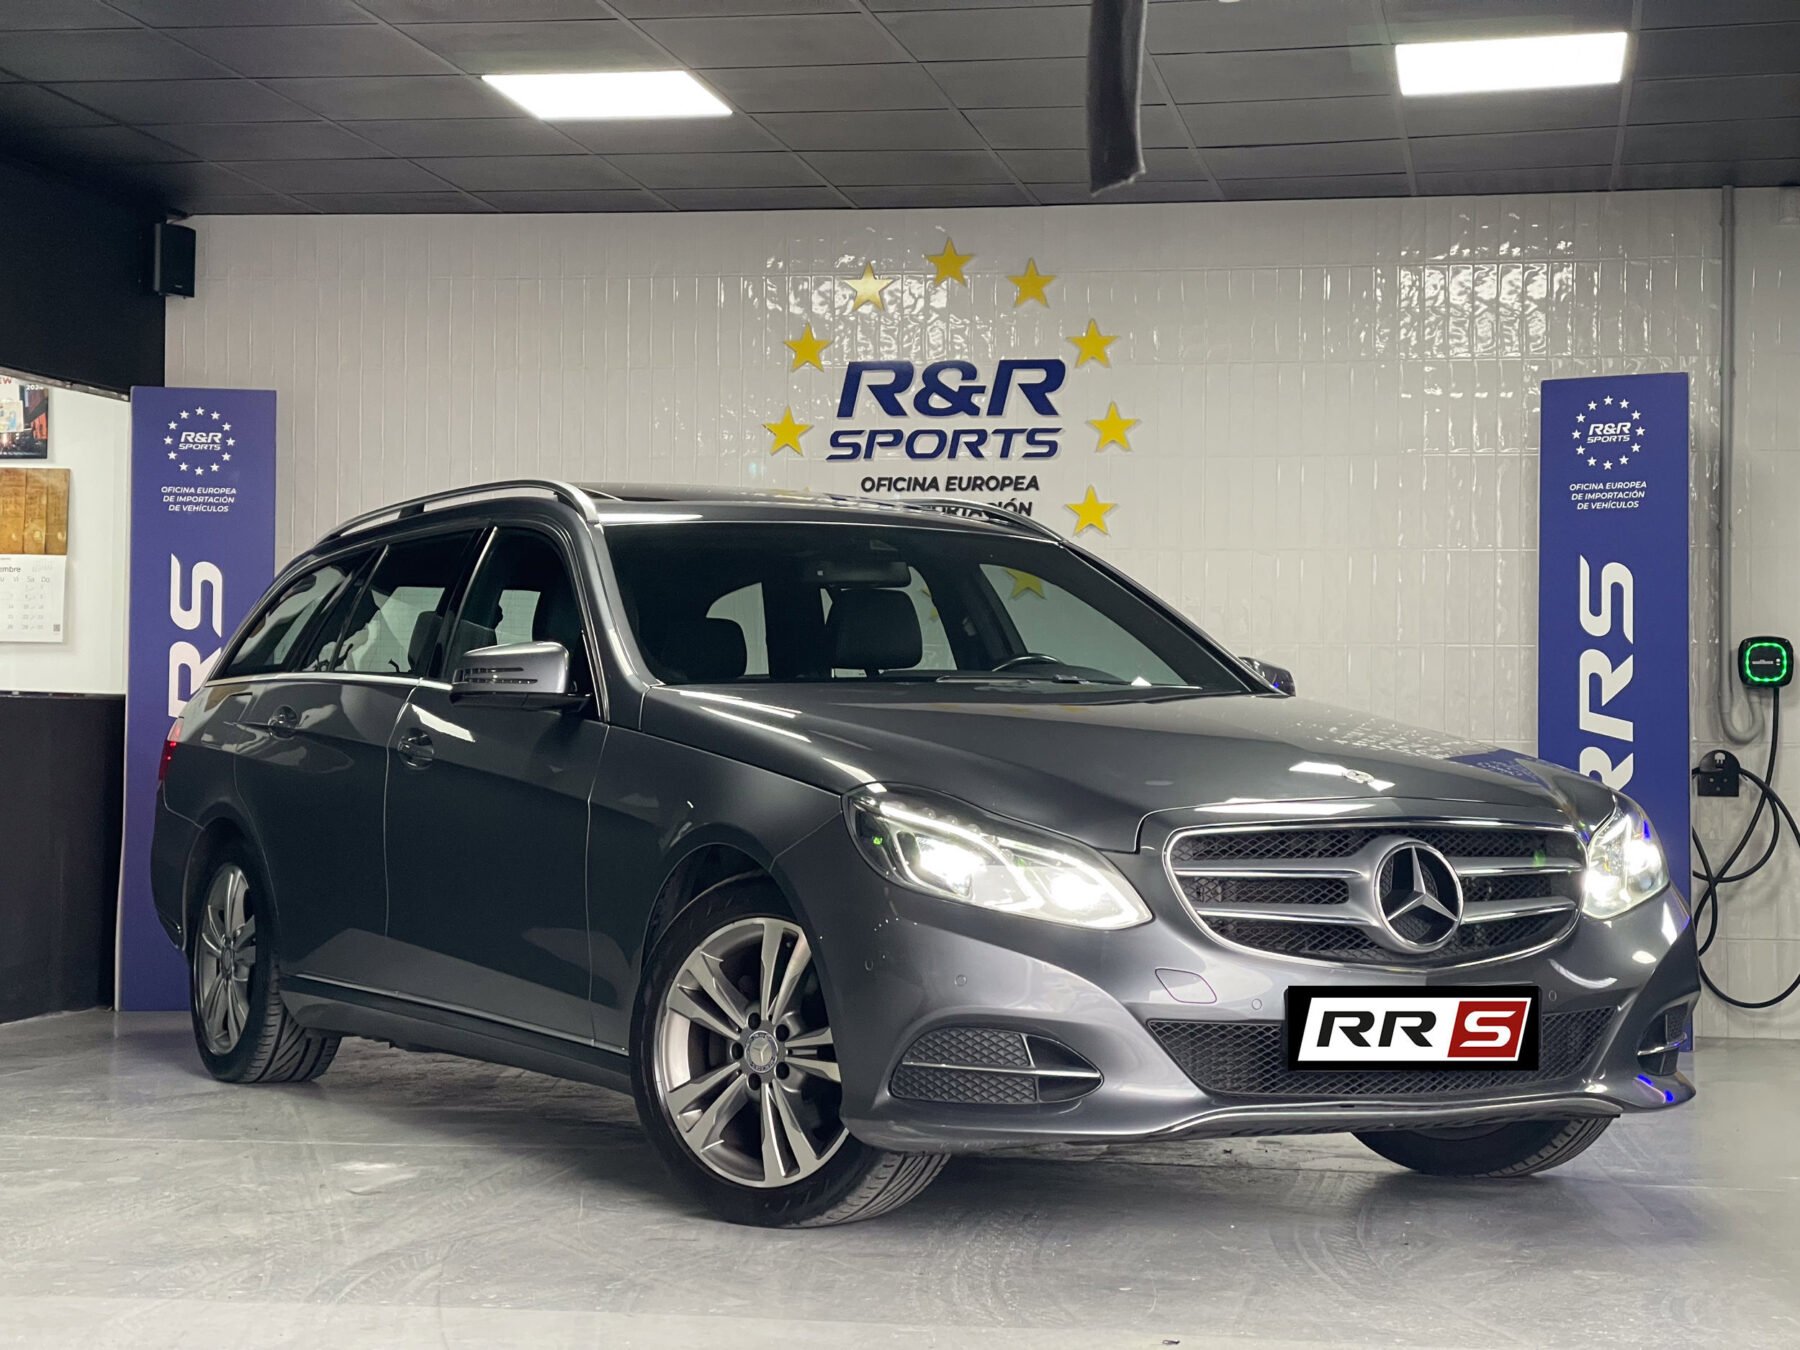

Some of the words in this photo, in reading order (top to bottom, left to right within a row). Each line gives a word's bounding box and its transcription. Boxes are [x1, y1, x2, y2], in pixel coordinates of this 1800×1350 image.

[836, 358, 1067, 418] R&R
[1588, 422, 1632, 436] R&R
[180, 431, 222, 443] R&R
[1586, 434, 1631, 444] SPORTS
[178, 443, 222, 451] SPORTS
[825, 427, 1063, 461] SPORTS
[860, 475, 940, 493] OFICINA
[944, 475, 1040, 492] EUROPEA
[1569, 482, 1604, 491] OFICINA
[1605, 480, 1647, 490] EUROPEA
[160, 486, 195, 494] OFICINA
[196, 486, 237, 494] EUROPEA
[1571, 493, 1584, 501] DE
[1584, 490, 1646, 500] IMPORTACIÓN
[176, 495, 235, 504] IMPORTACIÓN
[1576, 502, 1590, 510] DE
[1591, 500, 1640, 510] VEHÍCULOS
[182, 504, 230, 512] VEHÍCULOS
